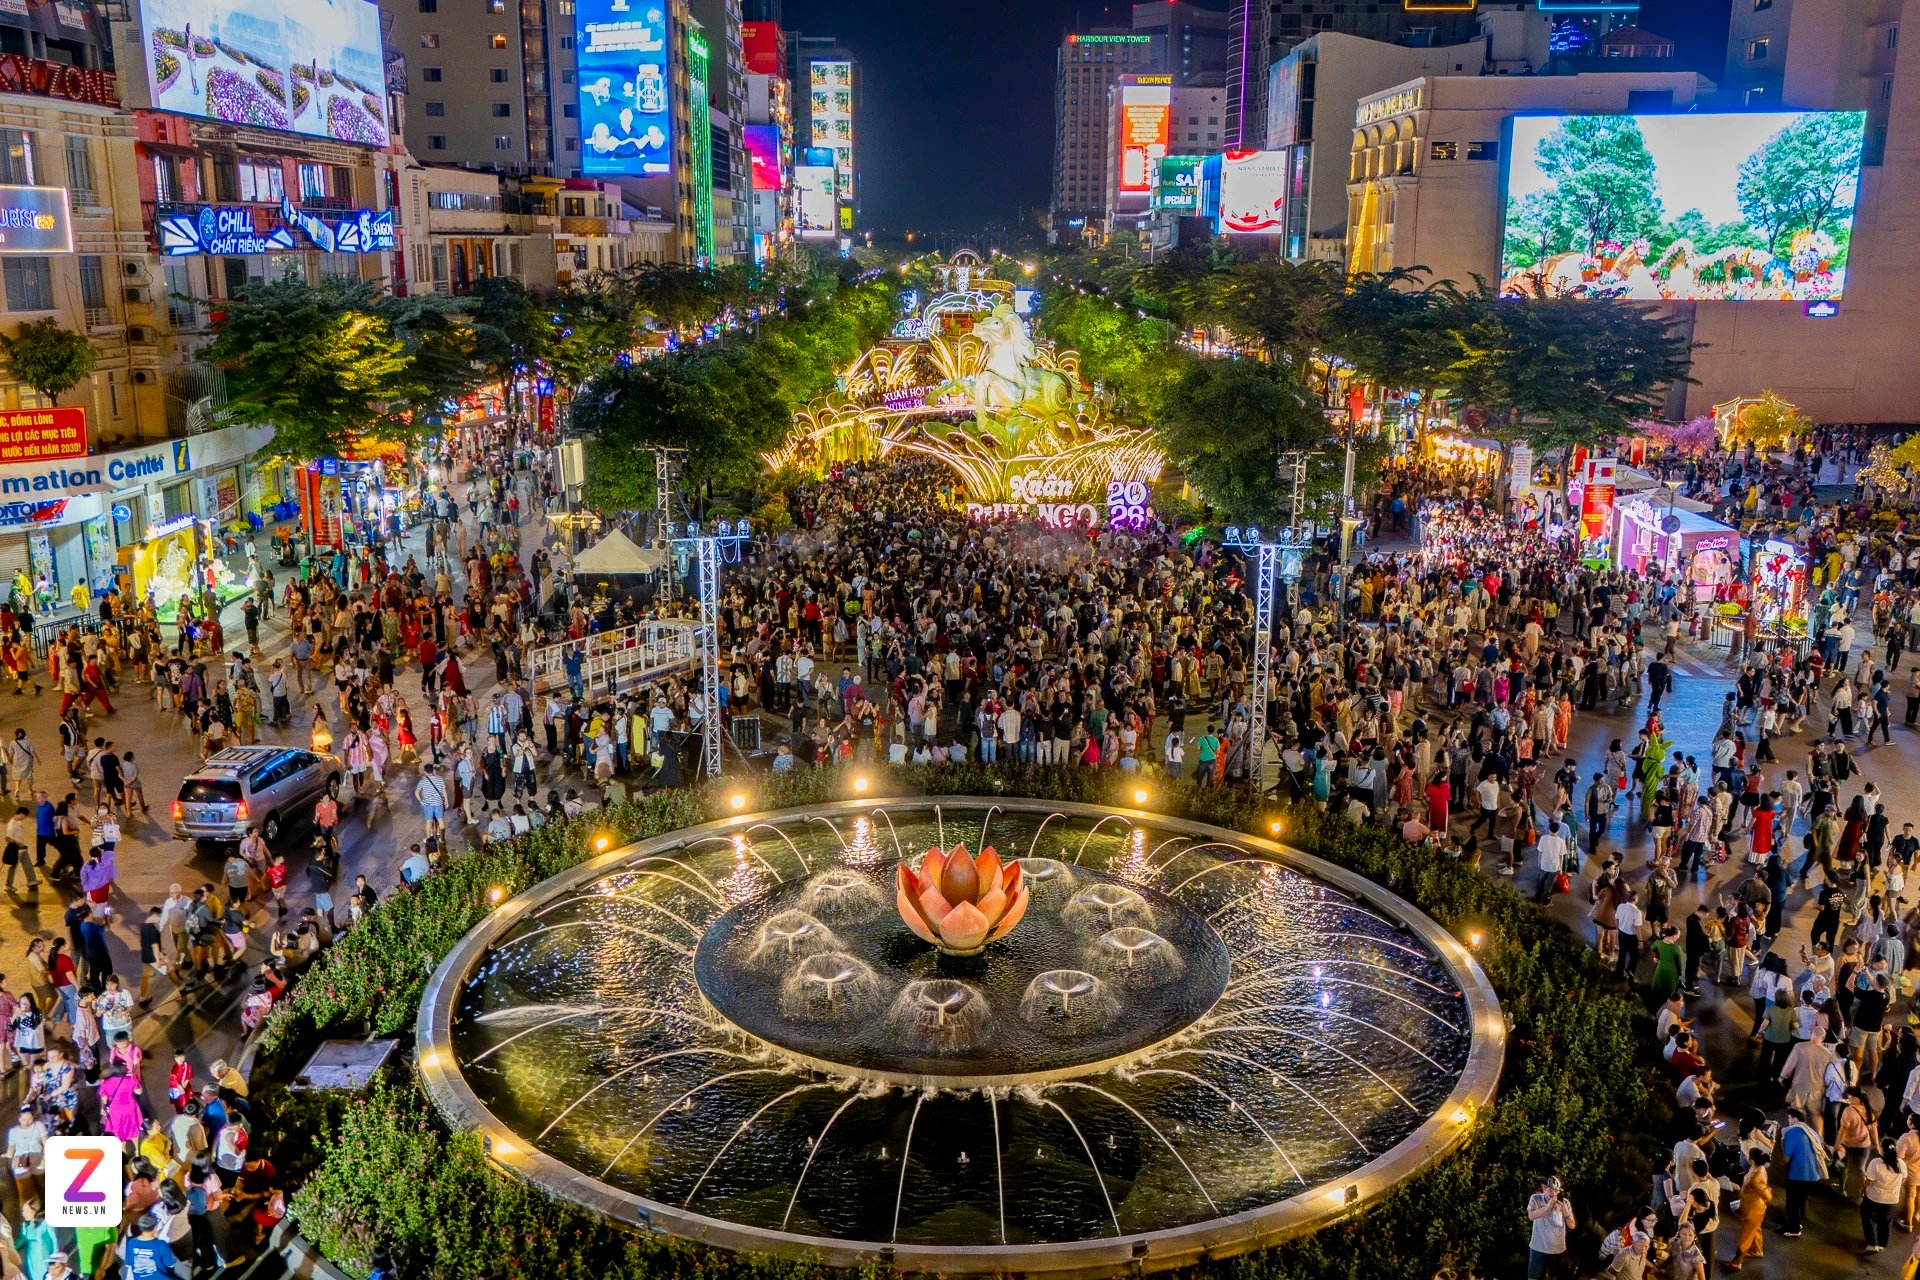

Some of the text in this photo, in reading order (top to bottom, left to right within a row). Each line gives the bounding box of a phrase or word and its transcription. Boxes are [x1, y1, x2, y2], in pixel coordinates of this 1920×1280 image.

[1077, 35, 1150, 43] HARBOUR VIEW TOWER
[45, 60, 121, 105] ZONE
[218, 211, 254, 233] CHILL
[210, 233, 266, 254] CHẤT RIÊNG
[10, 413, 33, 427] ĐỒNG
[33, 412, 54, 425] LÒNG
[11, 430, 23, 443] LỢI
[24, 429, 40, 441] CÁC
[41, 429, 59, 442] MỤC
[60, 426, 77, 439] TIÊU
[1, 442, 82, 458] NƯỚC ĐẾN NĂM 2030!
[108, 454, 165, 482] Center
[1009, 470, 1074, 504] Xuân
[1107, 482, 1147, 506] 20
